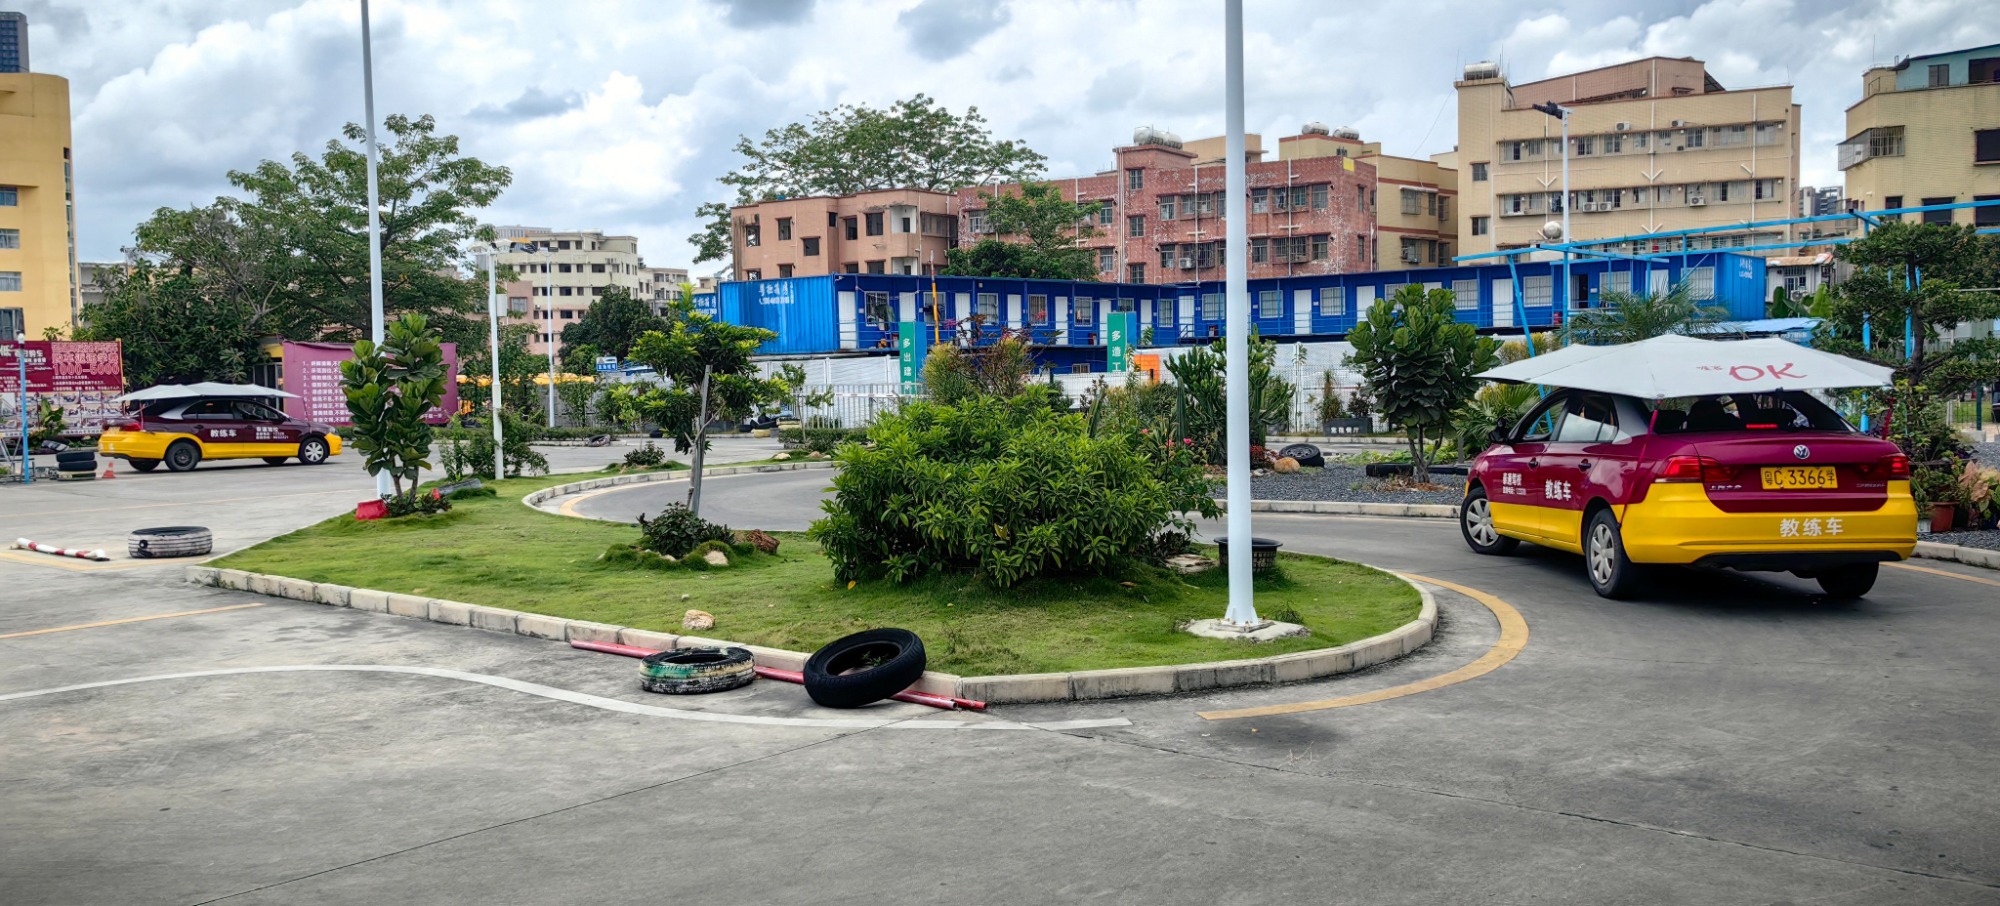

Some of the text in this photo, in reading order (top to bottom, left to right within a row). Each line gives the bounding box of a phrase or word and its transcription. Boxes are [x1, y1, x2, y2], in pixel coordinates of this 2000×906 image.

[1729, 362, 1808, 381] OK
[210, 429, 237, 438] 教练车
[1545, 479, 1572, 501] 教练车
[1779, 517, 1844, 538] 教练车
